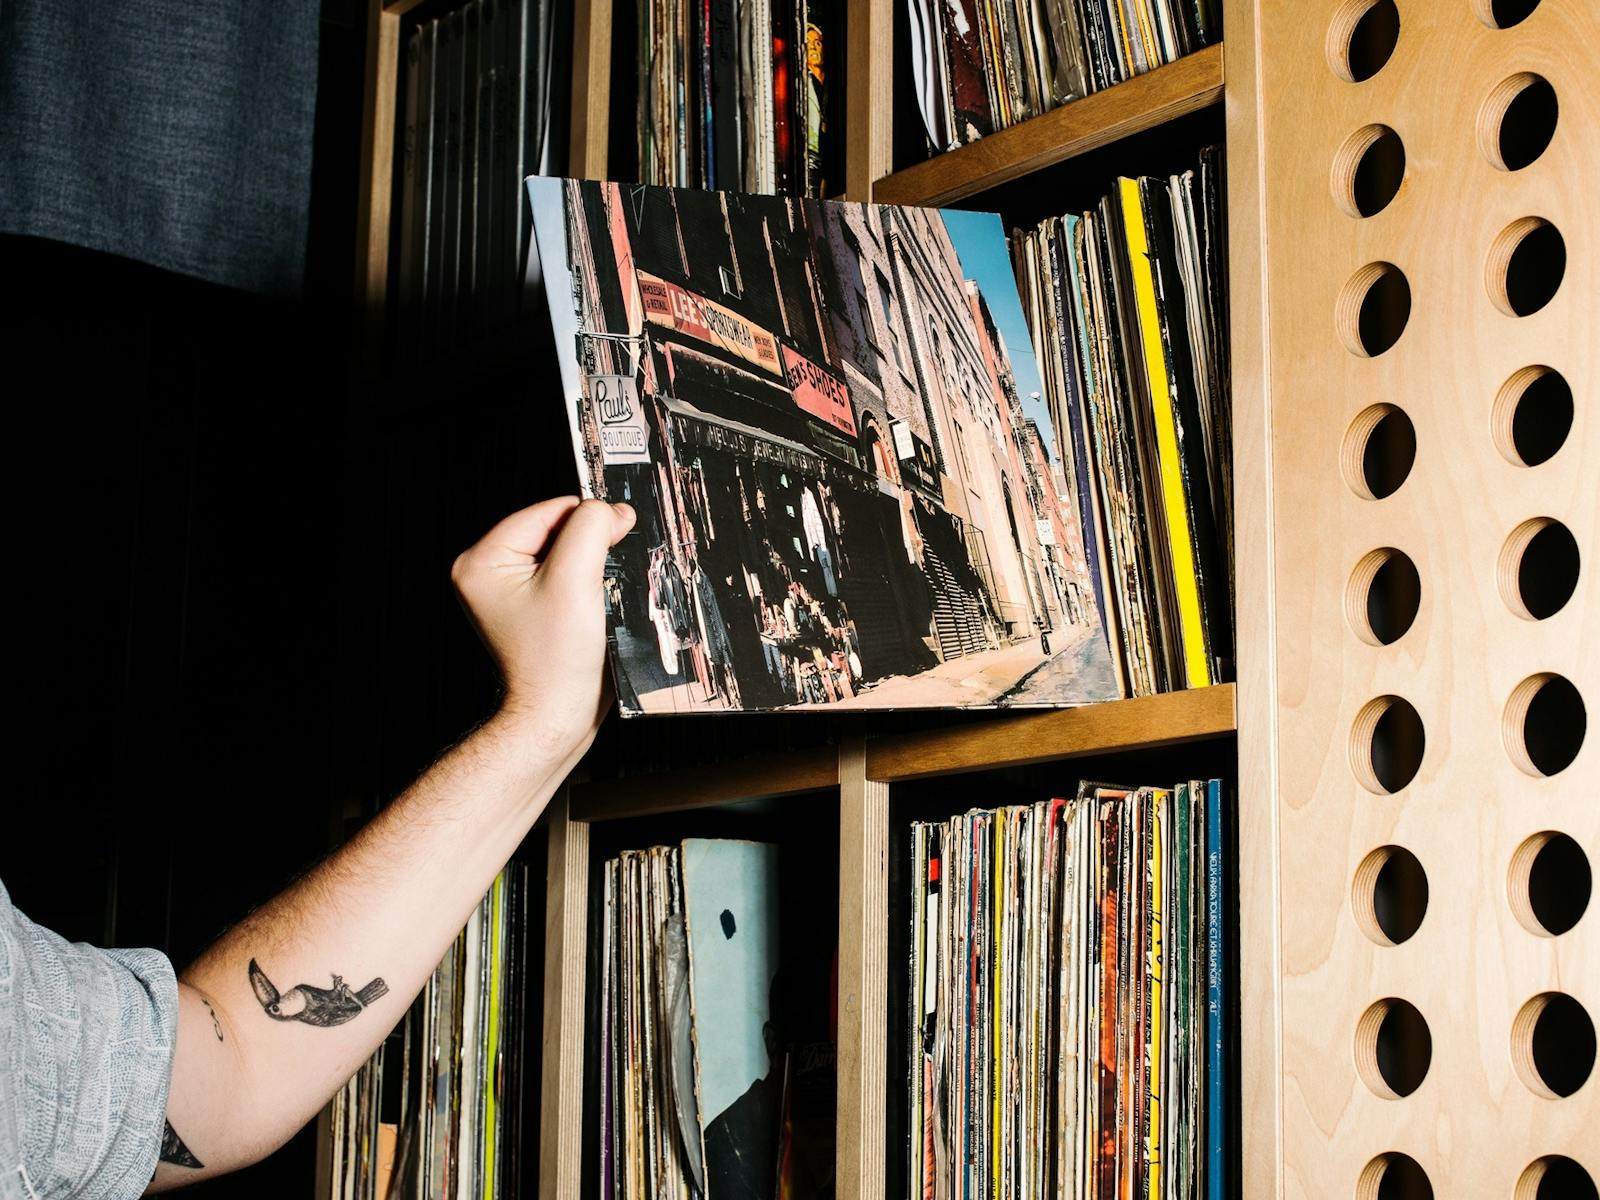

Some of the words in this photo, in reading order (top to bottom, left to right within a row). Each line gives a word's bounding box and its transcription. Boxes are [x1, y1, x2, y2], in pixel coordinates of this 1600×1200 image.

[806, 361, 846, 408] SHOES
[602, 430, 644, 448] BOUTIQUE
[1208, 851, 1217, 876] VIEUX
[1208, 876, 1217, 900] FARKA
[1208, 927, 1218, 938] ET
